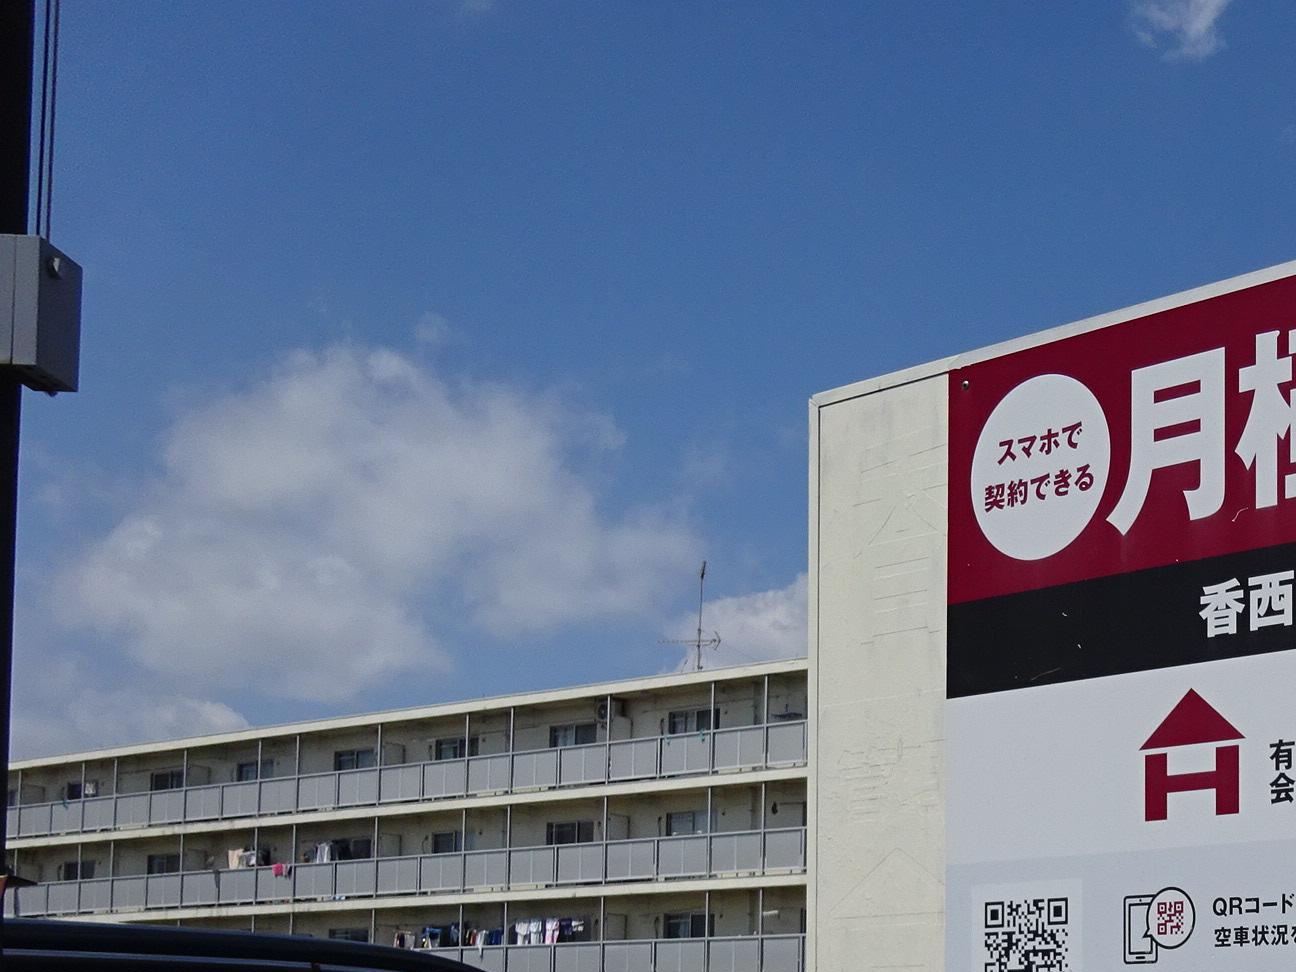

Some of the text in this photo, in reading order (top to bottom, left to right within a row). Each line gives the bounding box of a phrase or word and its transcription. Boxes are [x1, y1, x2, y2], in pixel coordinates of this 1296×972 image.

[997, 420, 1083, 465] スマホで
[984, 463, 1094, 513] 契約できる
